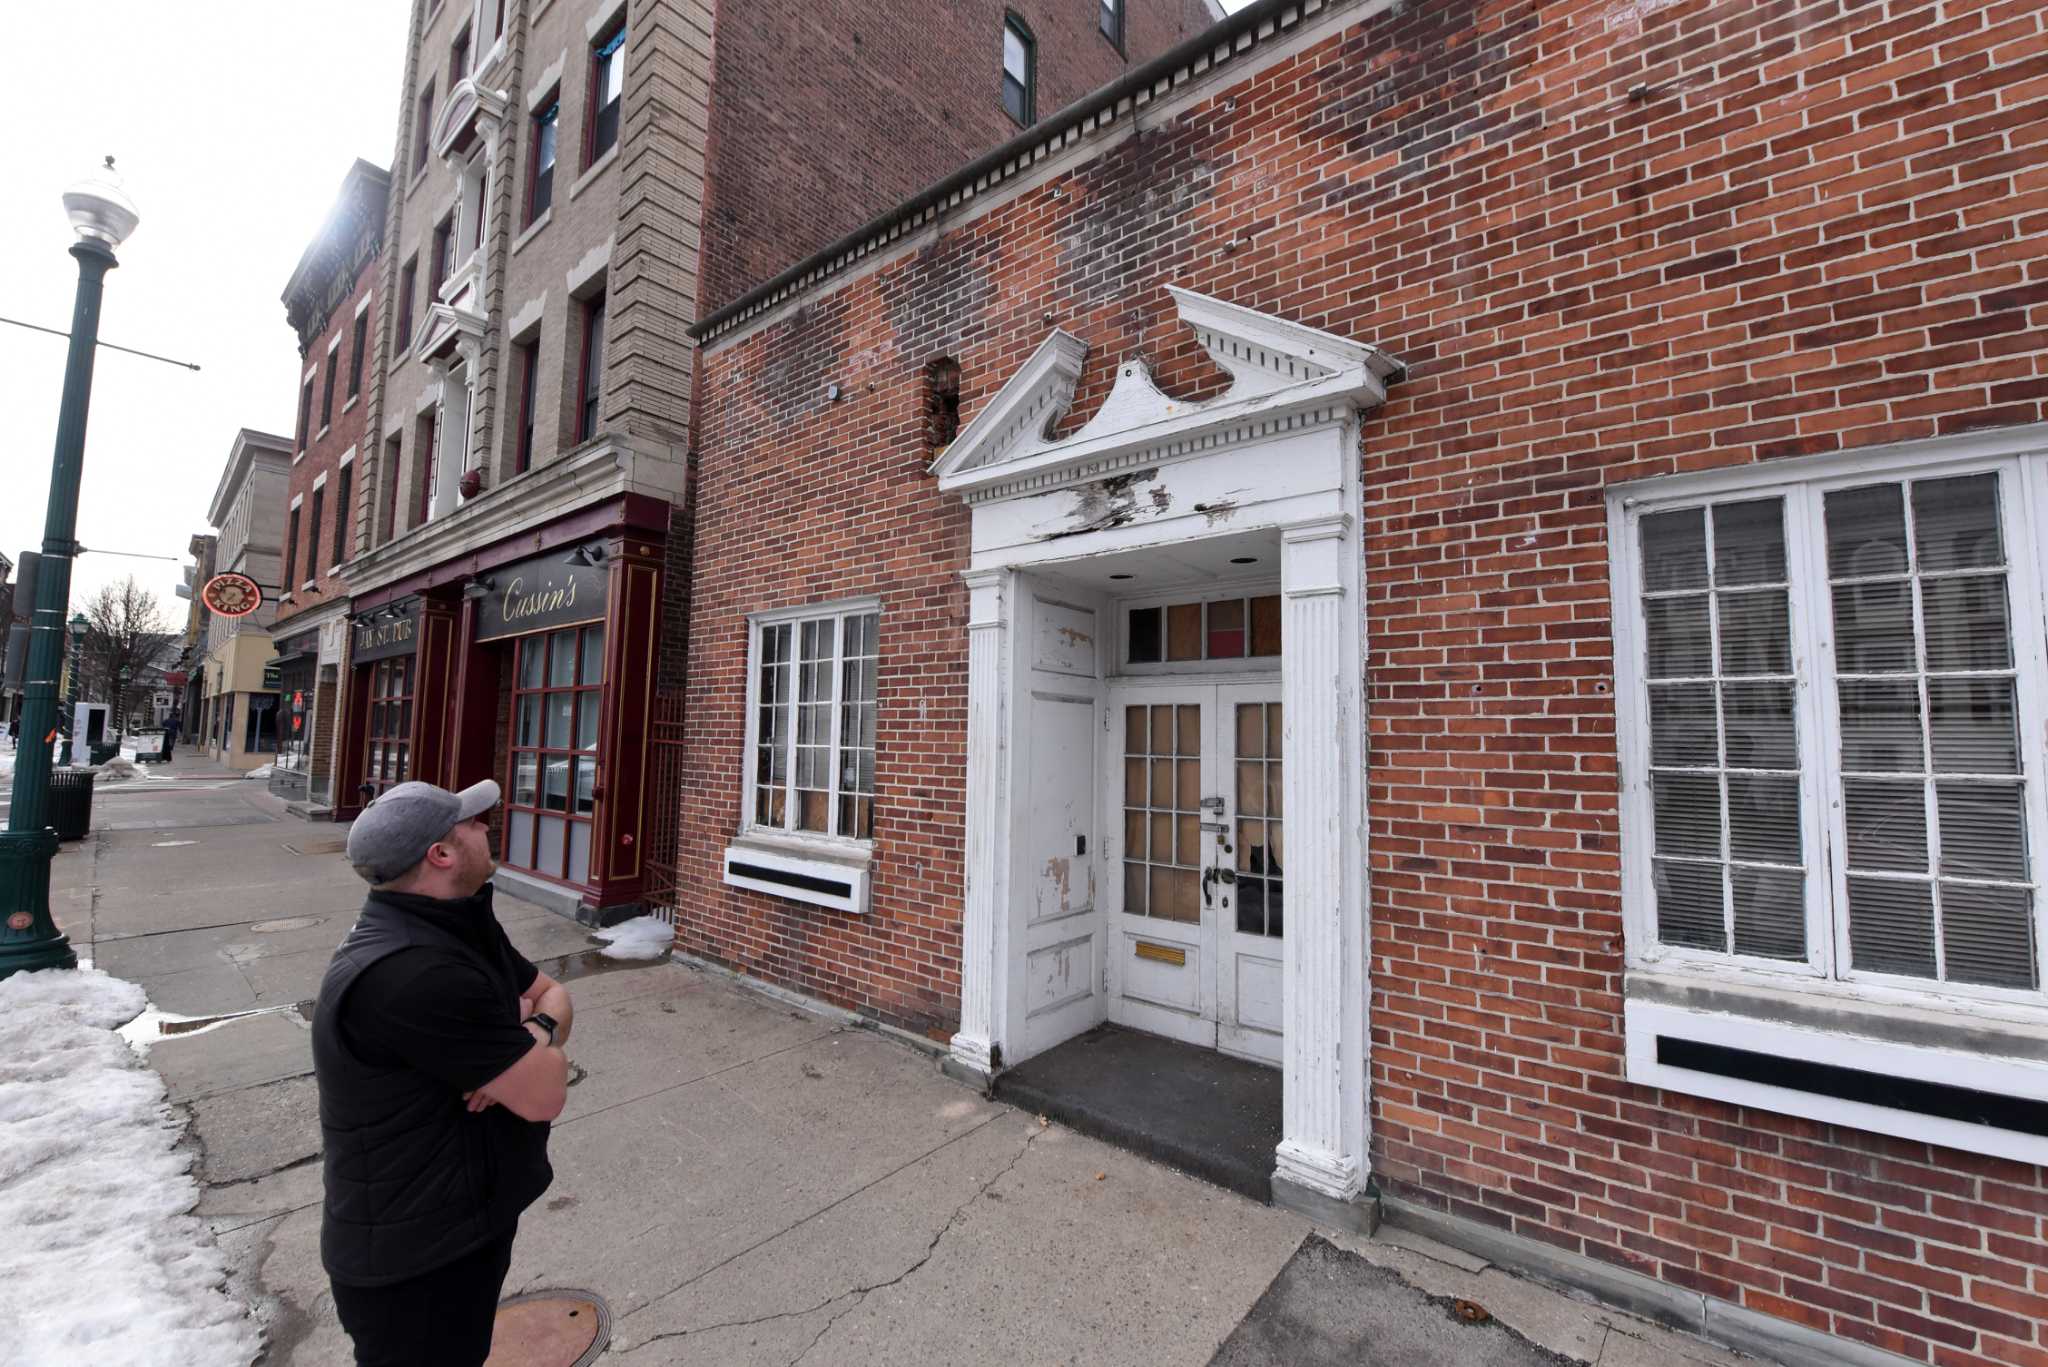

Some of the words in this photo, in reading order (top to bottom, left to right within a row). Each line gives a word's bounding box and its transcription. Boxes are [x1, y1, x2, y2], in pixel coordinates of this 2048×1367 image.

[213, 578, 252, 593] PIZZA
[213, 599, 250, 612] KING
[393, 618, 412, 642] PUB
